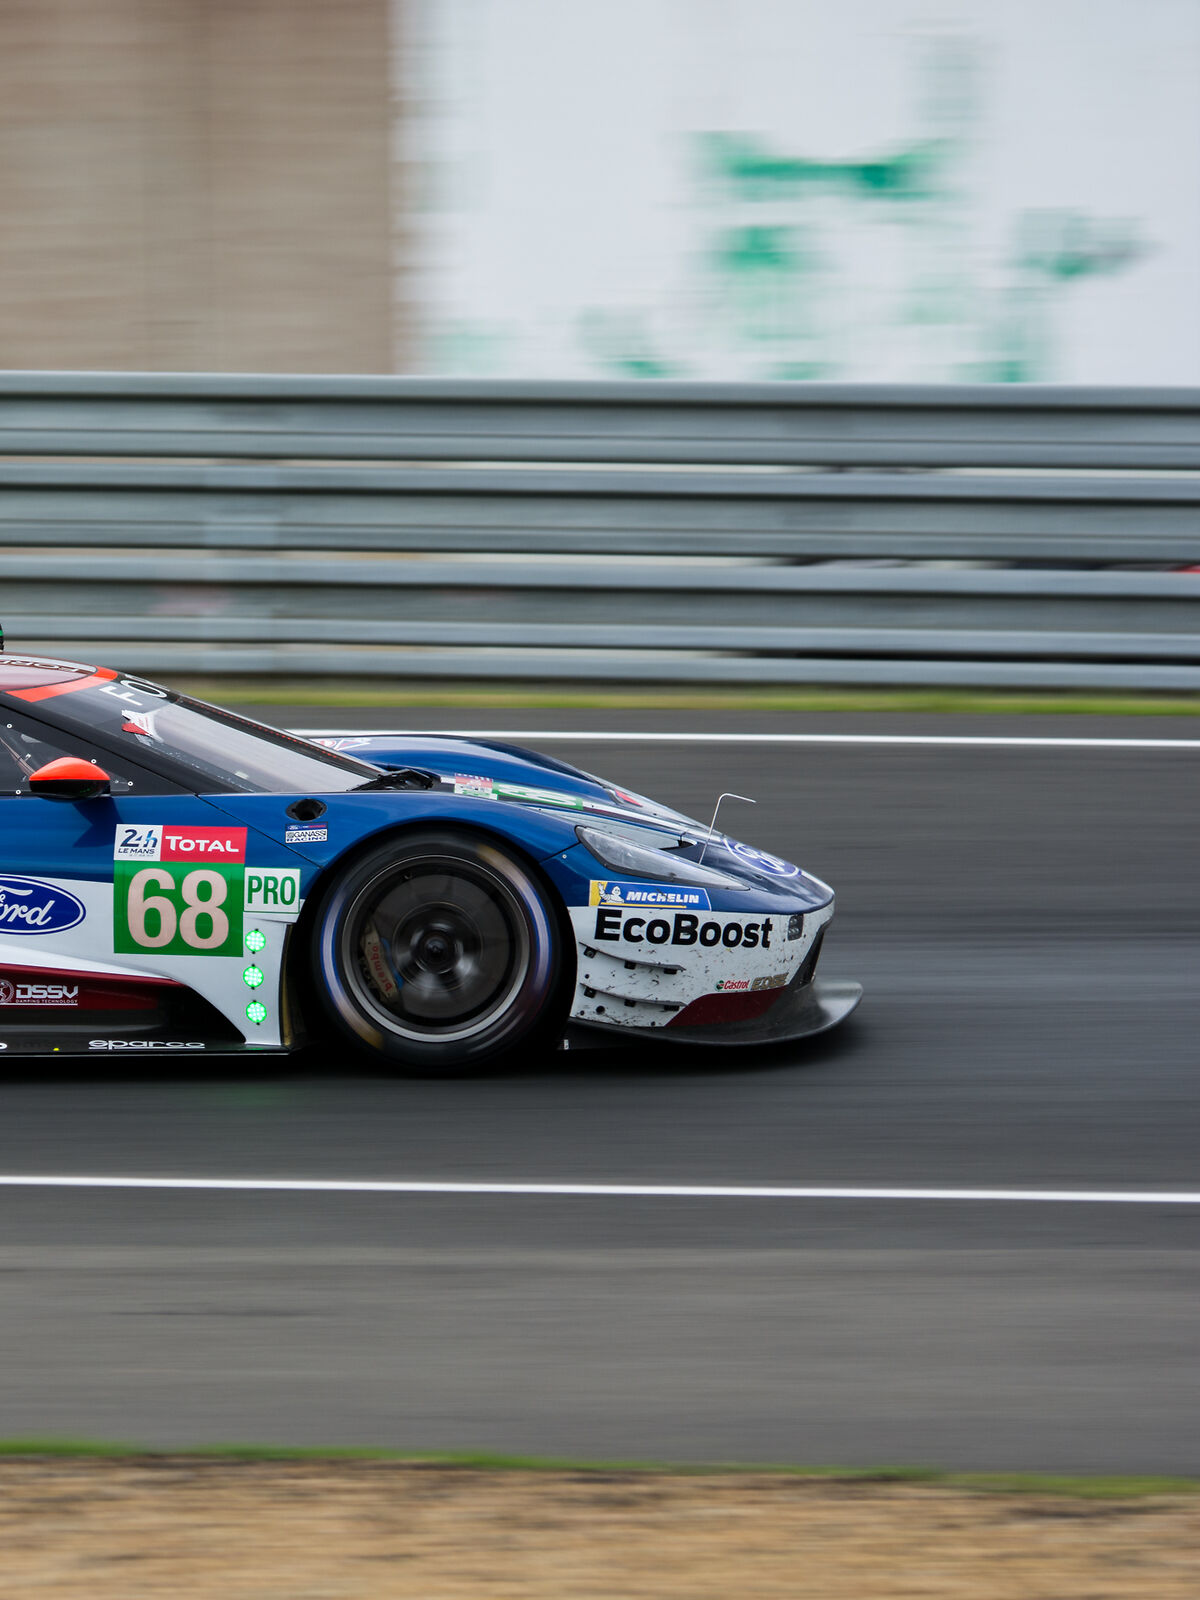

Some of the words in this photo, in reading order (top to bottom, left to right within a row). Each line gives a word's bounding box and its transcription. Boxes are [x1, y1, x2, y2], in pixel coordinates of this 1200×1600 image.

[120, 828, 158, 848] 24h
[247, 875, 297, 906] PRO
[626, 890, 700, 905] MICHELIN
[127, 868, 230, 950] 68
[594, 908, 773, 949] EcoBoost
[15, 984, 79, 999] DSSV
[723, 980, 750, 992] Castrol
[750, 973, 789, 991] EDGE
[88, 1039, 206, 1050] sparco
